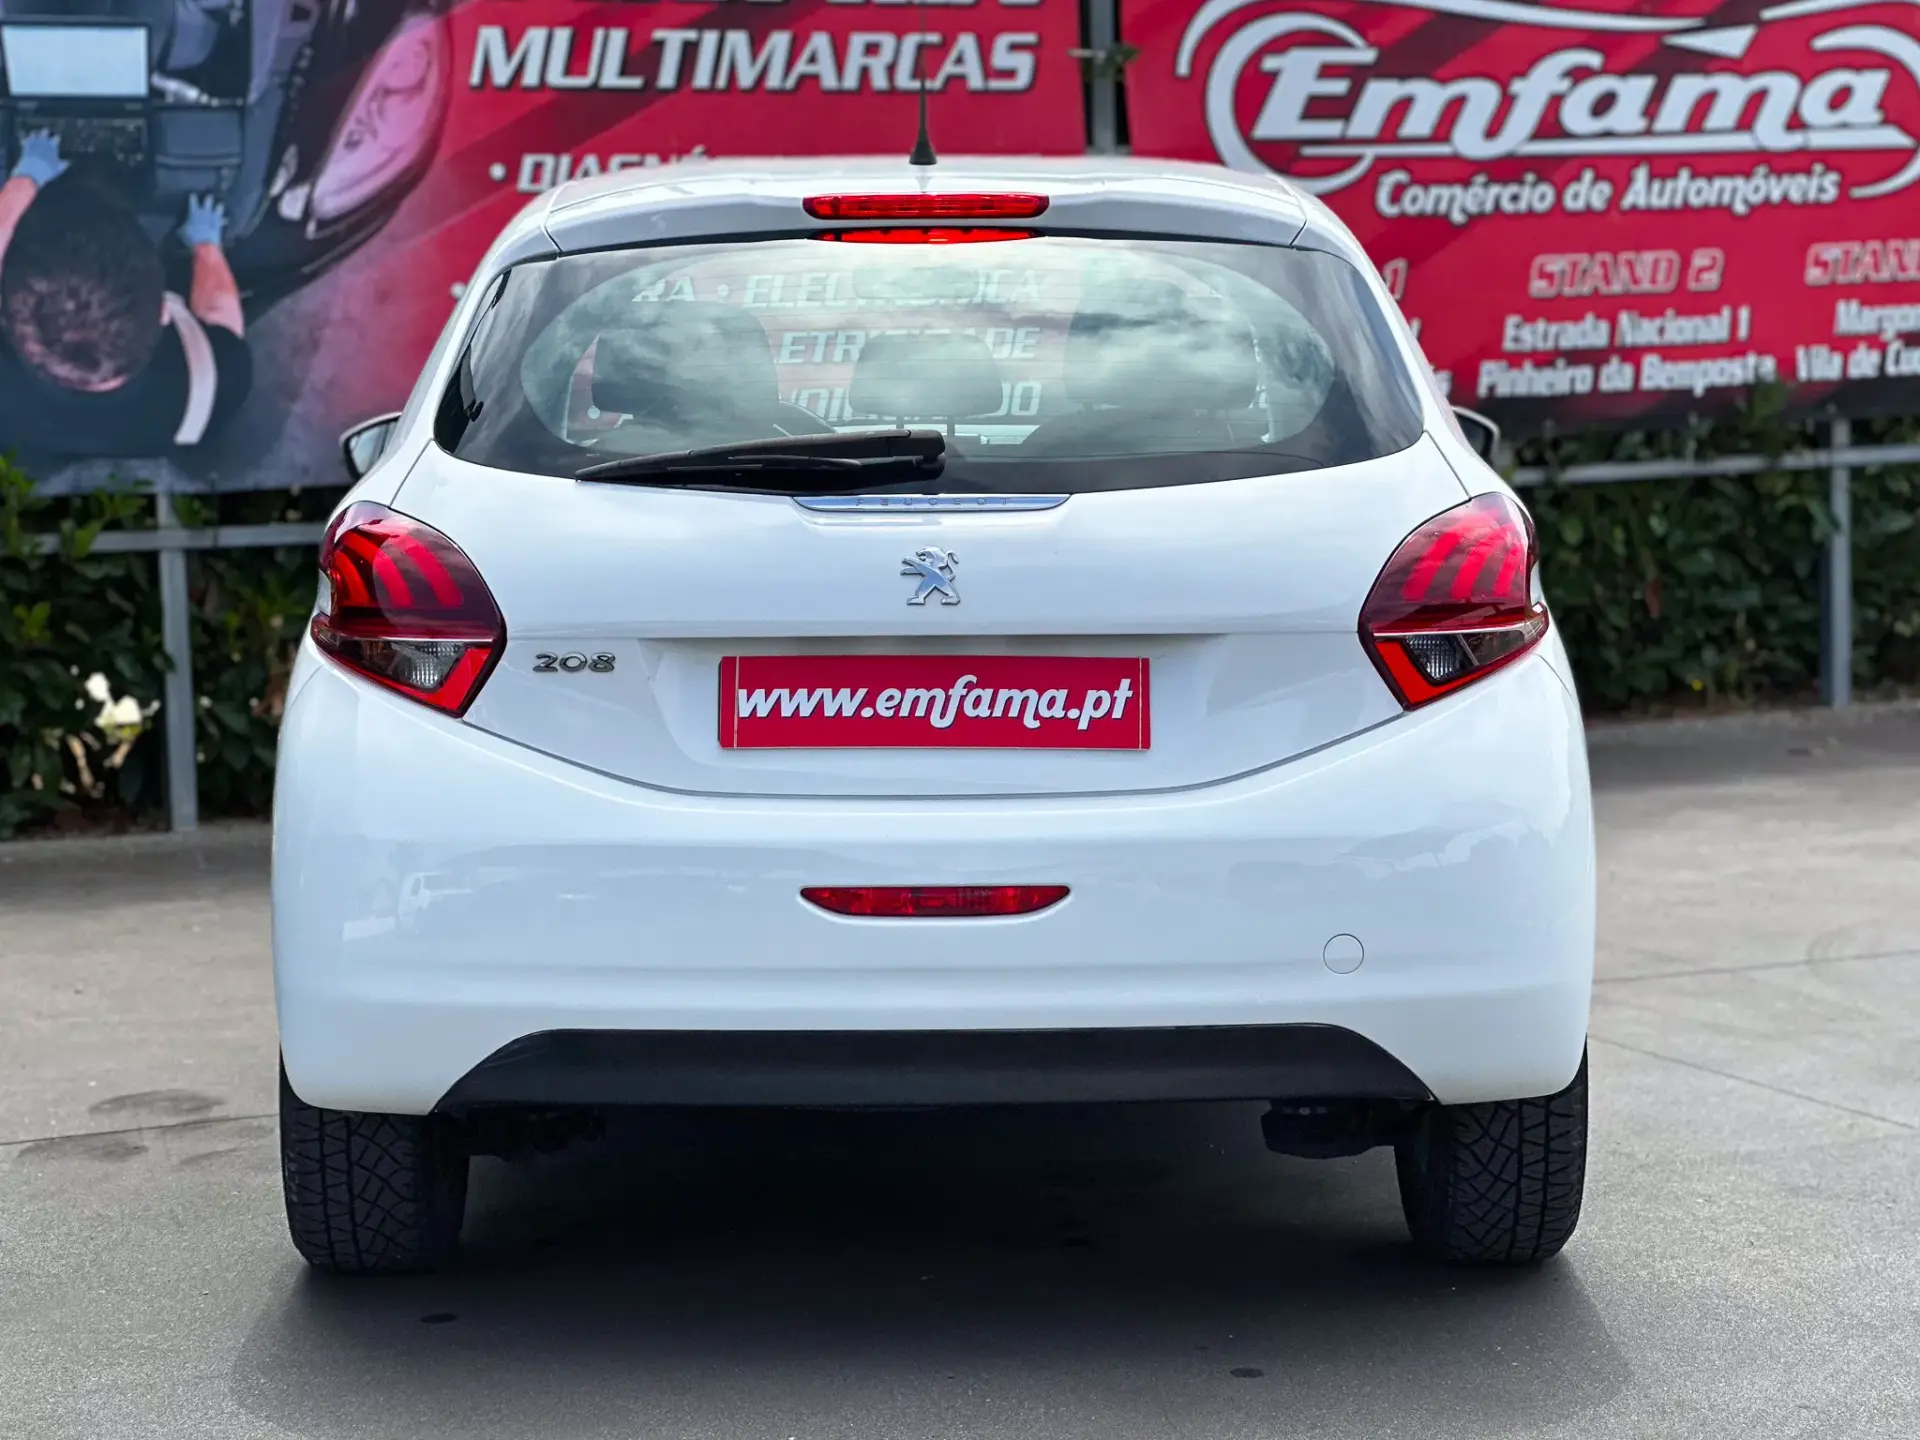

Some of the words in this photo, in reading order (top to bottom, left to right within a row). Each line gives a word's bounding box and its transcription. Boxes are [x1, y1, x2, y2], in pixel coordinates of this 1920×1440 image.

[470, 27, 1038, 92] MULTIMARCAS
[1250, 46, 1892, 160] Emfama
[1376, 170, 1555, 225] Comércio
[1562, 166, 1612, 213] de
[1620, 161, 1841, 216] Automóveis
[1530, 250, 1680, 298] STAND
[1687, 247, 1724, 291] 2
[1502, 313, 1611, 352] Estrada
[1615, 306, 1732, 347] Nacional
[1477, 358, 1595, 400] Pinheiro
[532, 651, 616, 673] 208
[737, 674, 1132, 730] www.emfama.pt
